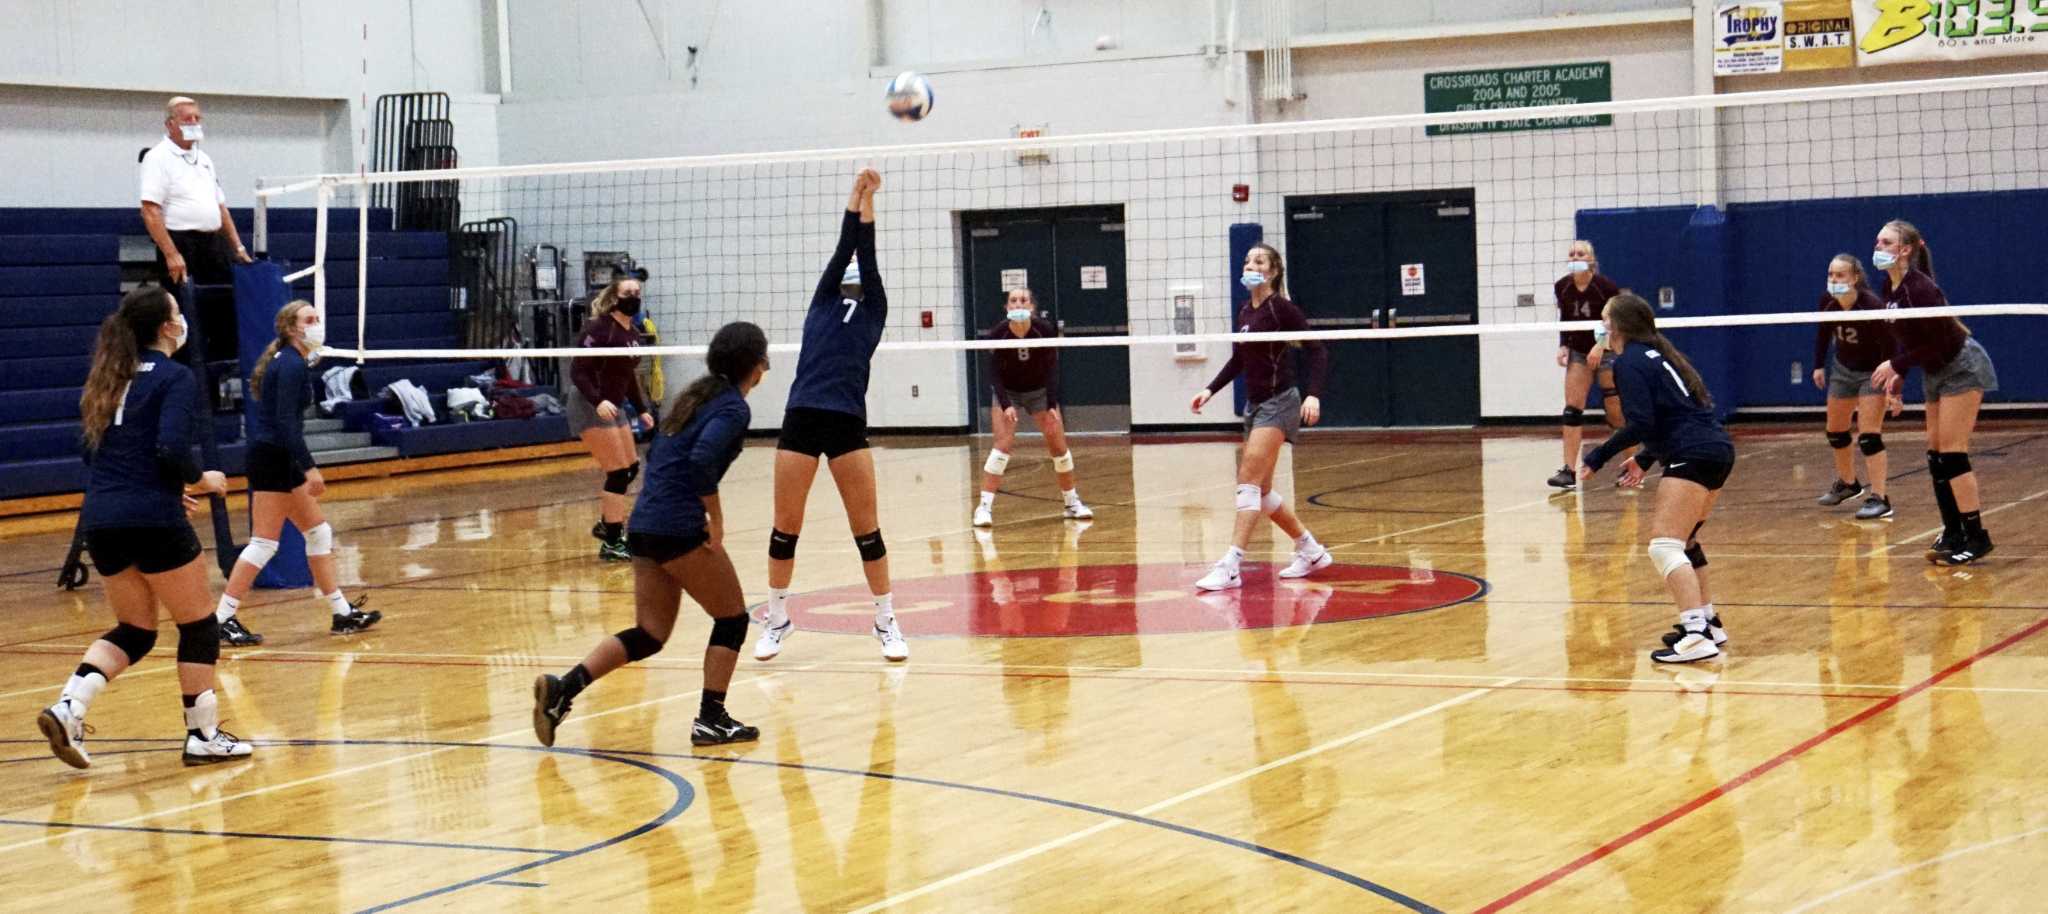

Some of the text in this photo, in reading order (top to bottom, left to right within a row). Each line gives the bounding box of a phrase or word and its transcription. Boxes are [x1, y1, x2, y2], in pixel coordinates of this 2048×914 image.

[1786, 18, 1849, 34] ORIGINAL
[1973, 37, 1996, 46] and
[2001, 34, 2035, 45] More
[1430, 66, 1605, 89] CROSSROADS CHARTER ACADEMY
[1473, 84, 1561, 102] 2004 AND 2005
[842, 298, 858, 324] 7
[1572, 301, 1591, 318] 14
[1836, 325, 1859, 344] 12
